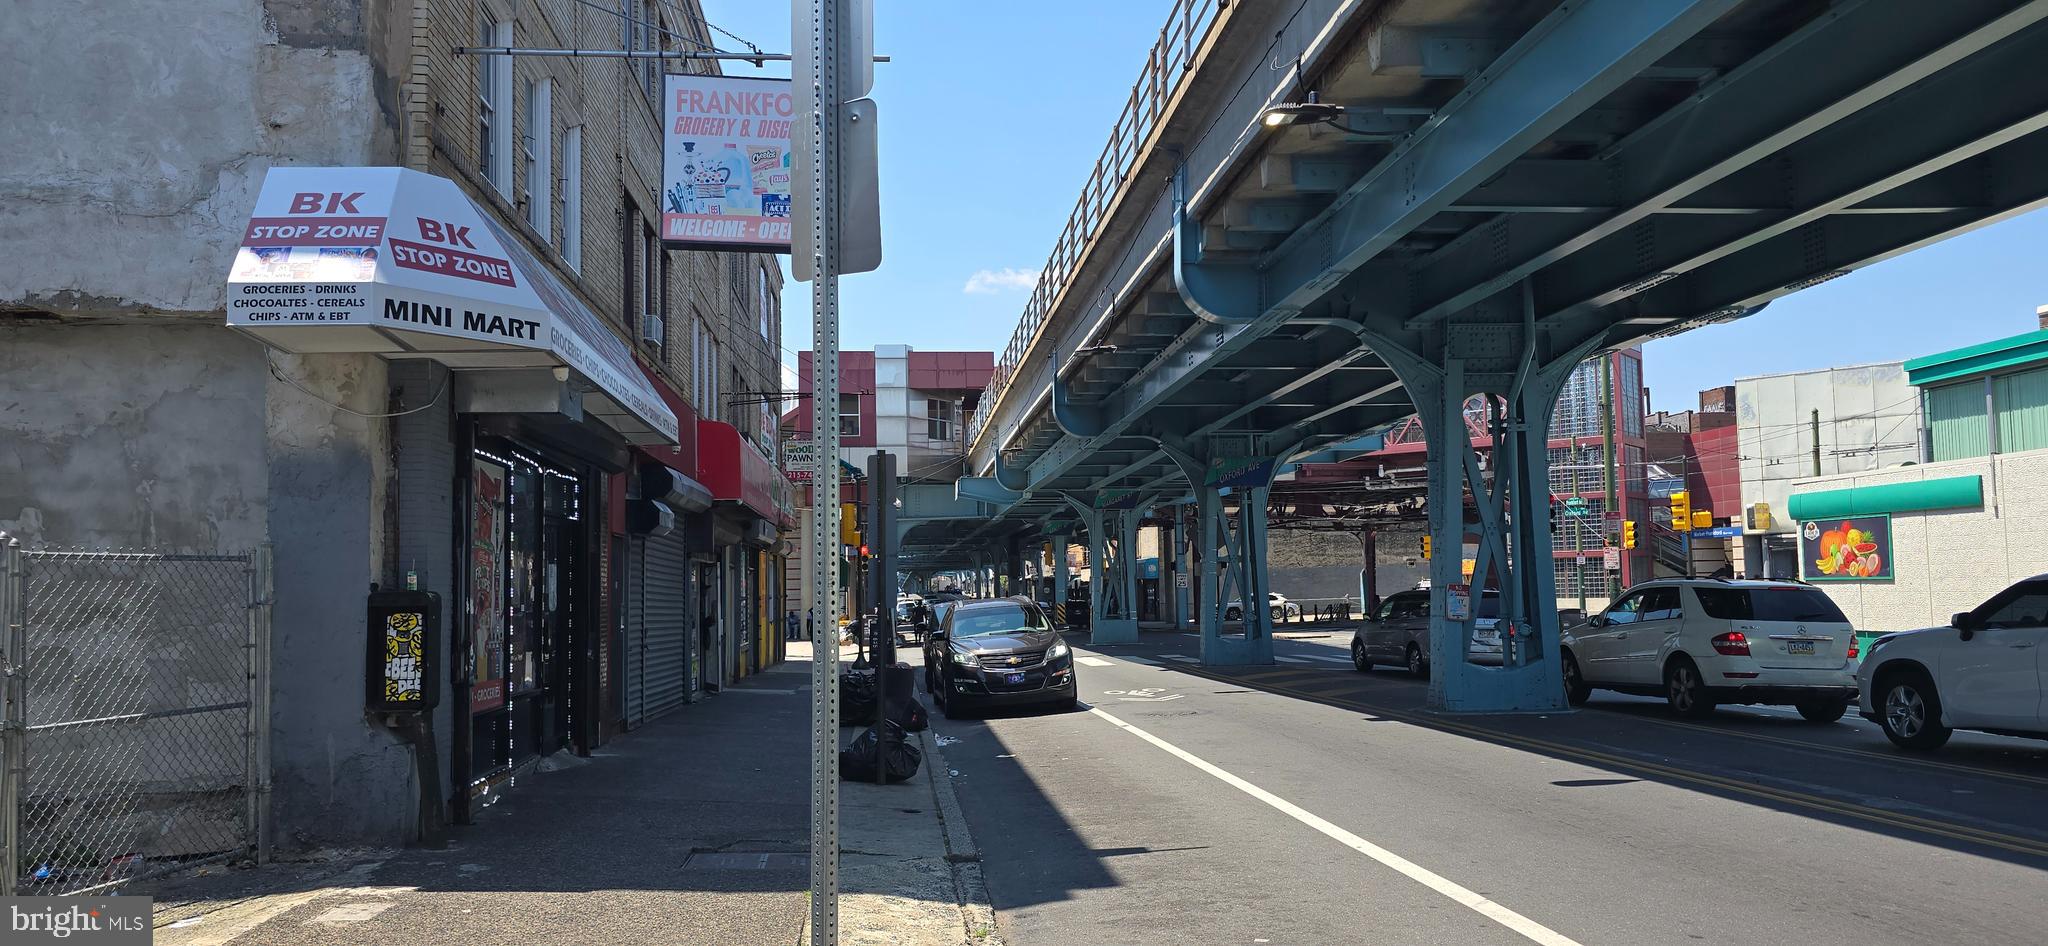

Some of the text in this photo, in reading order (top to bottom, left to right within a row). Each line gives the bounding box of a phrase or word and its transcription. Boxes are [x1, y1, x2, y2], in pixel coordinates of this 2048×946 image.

[676, 89, 793, 117] FRANKFO
[674, 116, 792, 139] GROCERY & DISC
[752, 149, 776, 164] Cheetos
[288, 192, 366, 214] BK
[251, 225, 379, 239] STOP ZONE
[416, 216, 477, 250] BK
[670, 218, 747, 238] WELCOME
[758, 221, 792, 240] OPE
[394, 246, 510, 280] STOP ZONE
[243, 285, 306, 295] GROCERIES
[315, 285, 357, 294] DRINKS
[233, 298, 307, 308] CHOCOALTES
[317, 298, 366, 307] CEREALS
[249, 312, 281, 321] CHIPS
[290, 312, 315, 321] ATM
[318, 312, 326, 320] &
[329, 311, 351, 321] EBT
[384, 298, 541, 341] MINI MART
[787, 454, 813, 462] PAWN
[1219, 466, 1245, 483] OXFORD
[391, 657, 416, 680] BEE
[477, 686, 500, 702] GROCERIES
